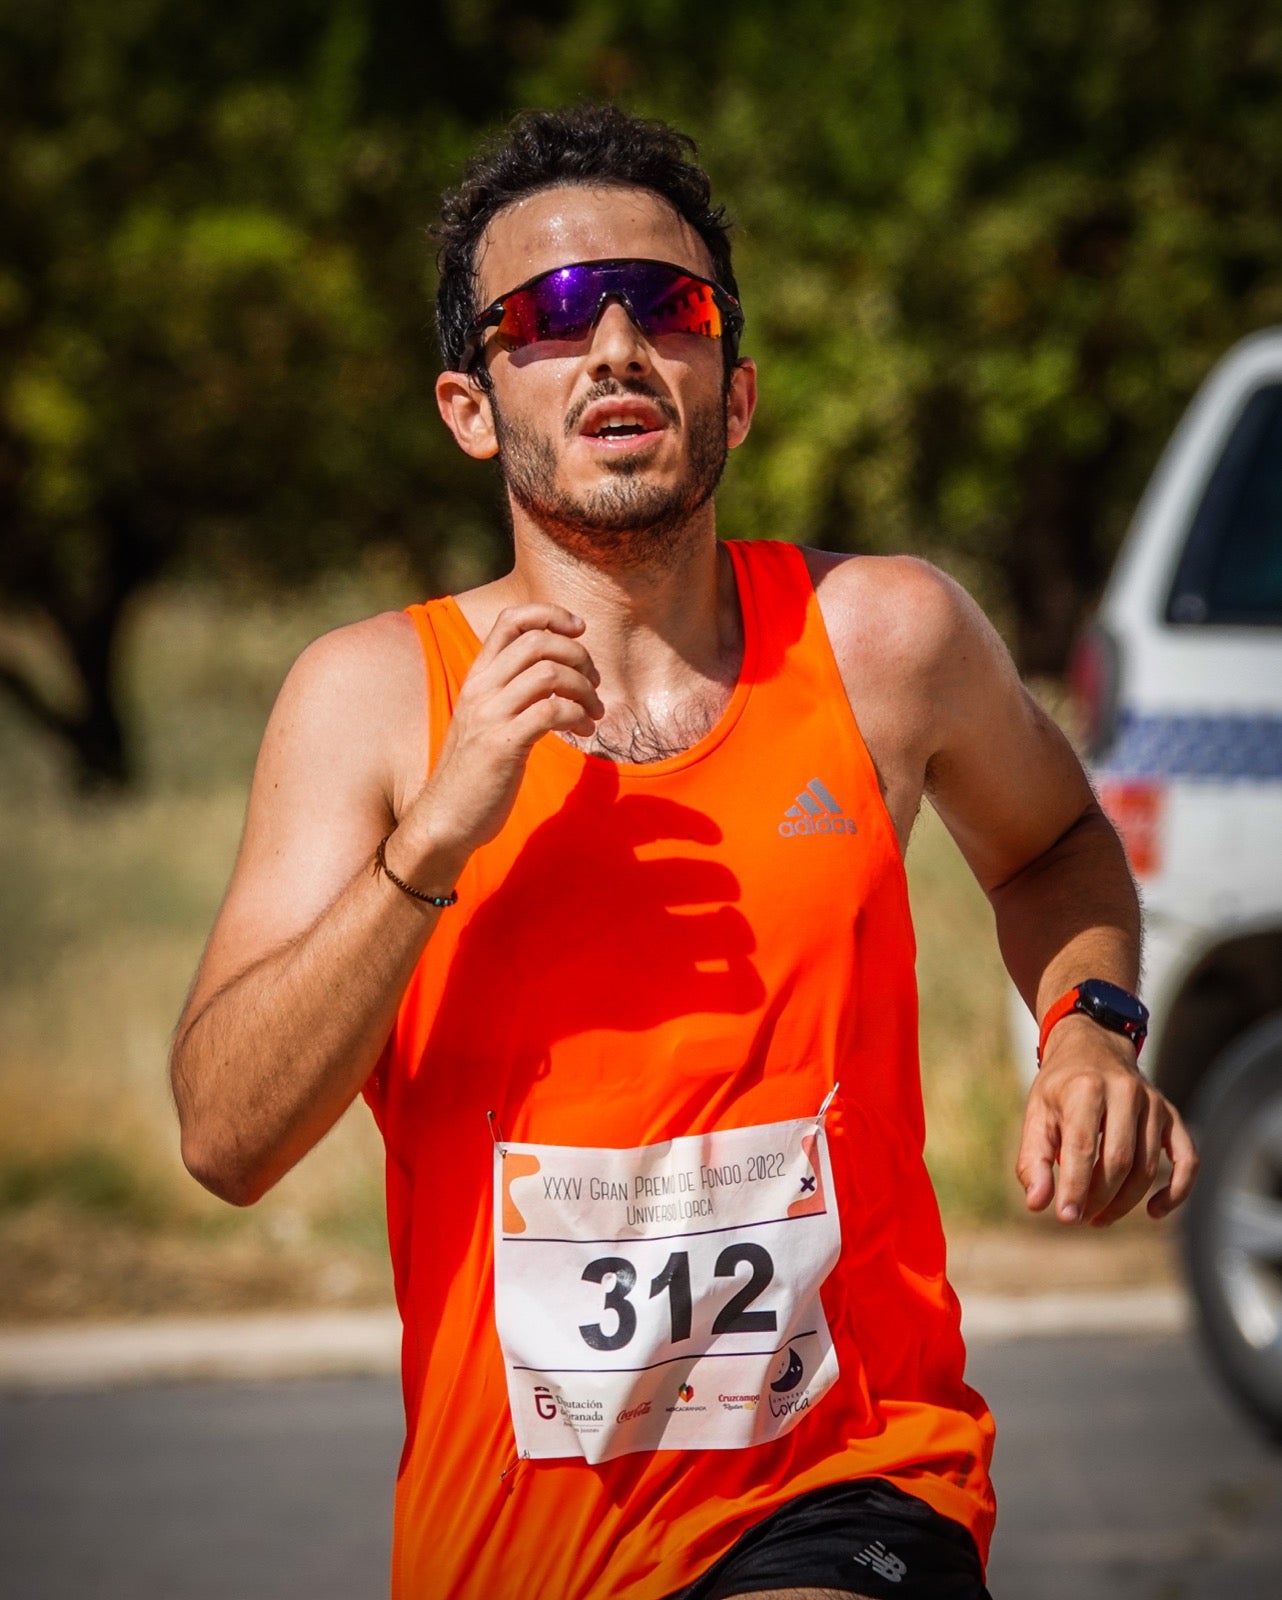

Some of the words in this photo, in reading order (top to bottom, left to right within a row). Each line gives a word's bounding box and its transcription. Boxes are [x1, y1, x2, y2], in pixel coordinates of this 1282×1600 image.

[778, 813, 857, 838] adidas
[543, 1176, 583, 1201] XXXV
[590, 1177, 628, 1201] GRAN
[678, 1171, 697, 1193] DE
[700, 1164, 742, 1190] FONDO
[746, 1152, 786, 1182] 2022
[678, 1198, 714, 1219] LORCA
[578, 1242, 778, 1352] 312
